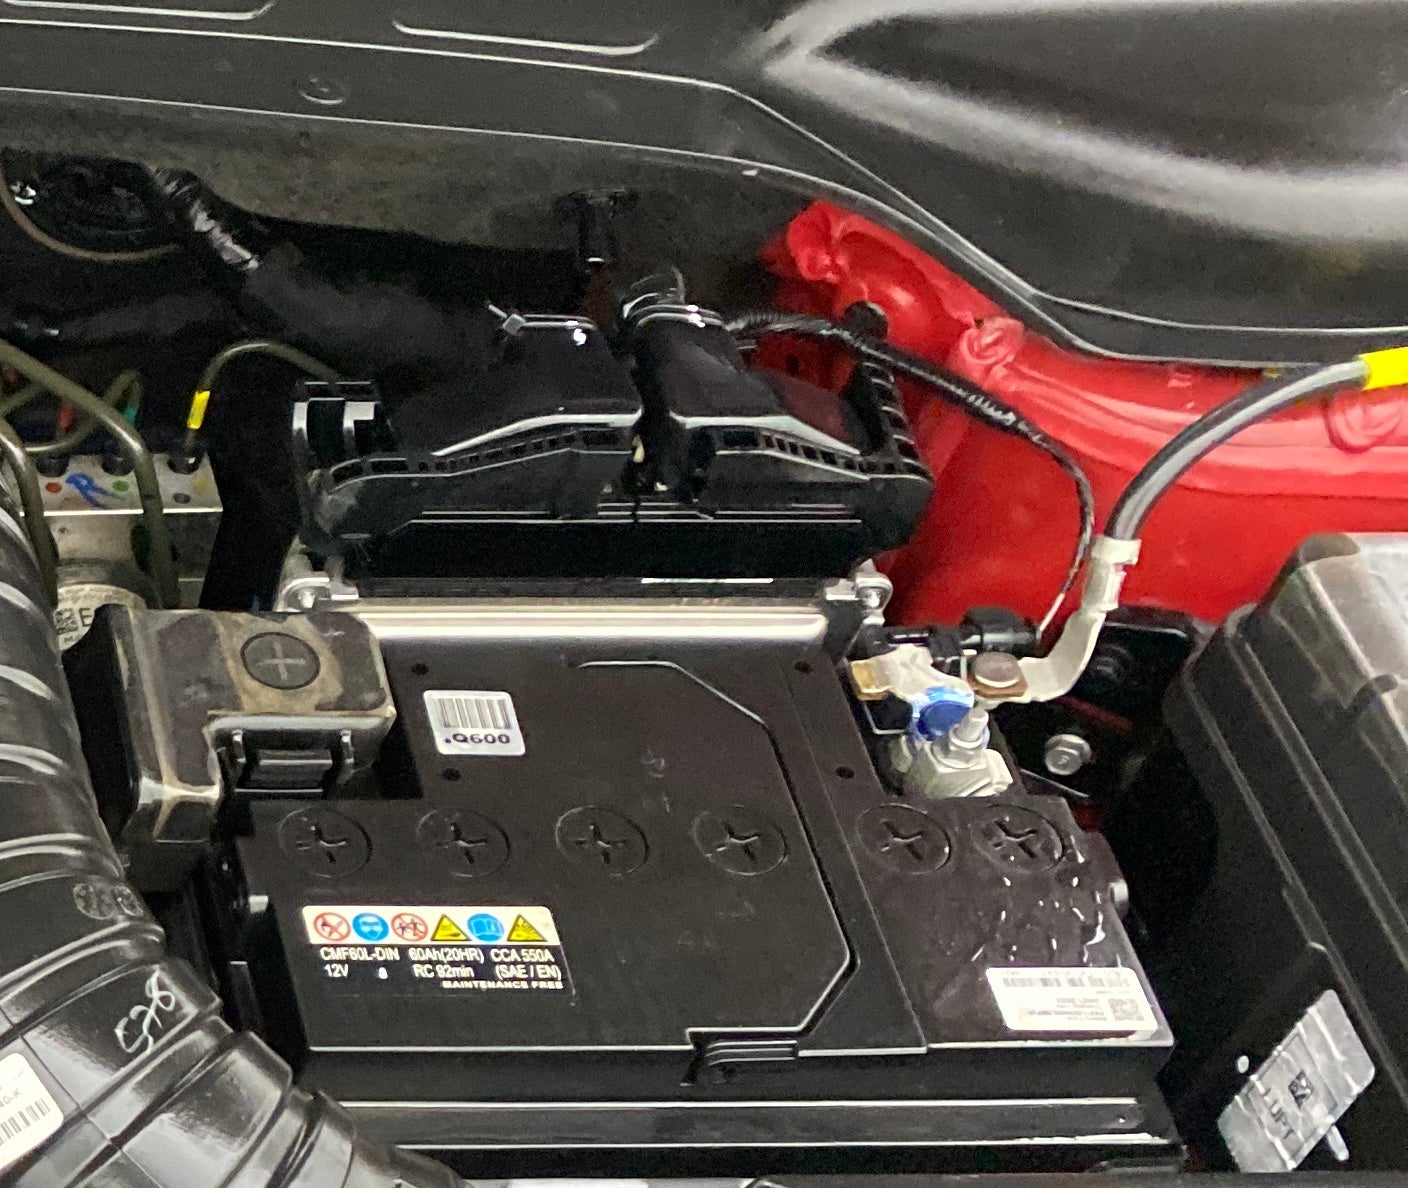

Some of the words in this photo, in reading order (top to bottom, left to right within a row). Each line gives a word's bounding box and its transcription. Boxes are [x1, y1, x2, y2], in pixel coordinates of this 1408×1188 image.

[490, 948, 521, 963] CCA
[521, 948, 555, 963] 550A
[323, 963, 350, 979] 12V
[412, 964, 434, 979] RC
